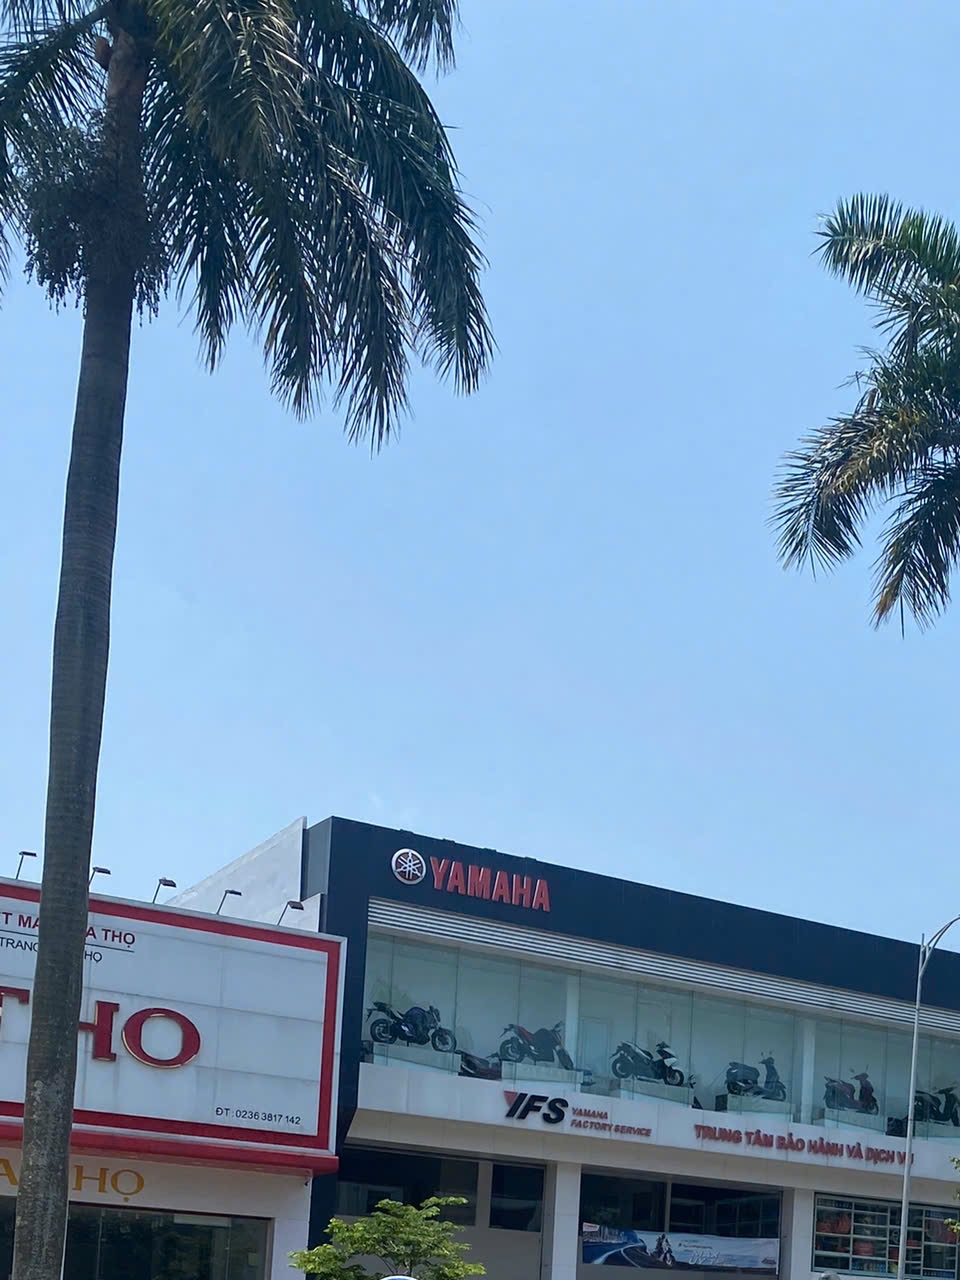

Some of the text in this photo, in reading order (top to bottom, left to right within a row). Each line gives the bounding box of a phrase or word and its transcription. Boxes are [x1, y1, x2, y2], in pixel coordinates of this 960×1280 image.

[430, 856, 550, 912] YAMAHA
[101, 928, 136, 948] THỌ
[84, 950, 103, 963] HỌ
[572, 1107, 608, 1119] YAMAHA
[570, 1120, 653, 1137] FACTORY SERVICE
[694, 1124, 742, 1144] TRUNG
[745, 1129, 774, 1148] TÂM
[776, 1132, 805, 1152] BẢO
[807, 1137, 844, 1157] HÀNH
[846, 1142, 864, 1159] VÀ
[72, 1165, 145, 1202] HỌ
